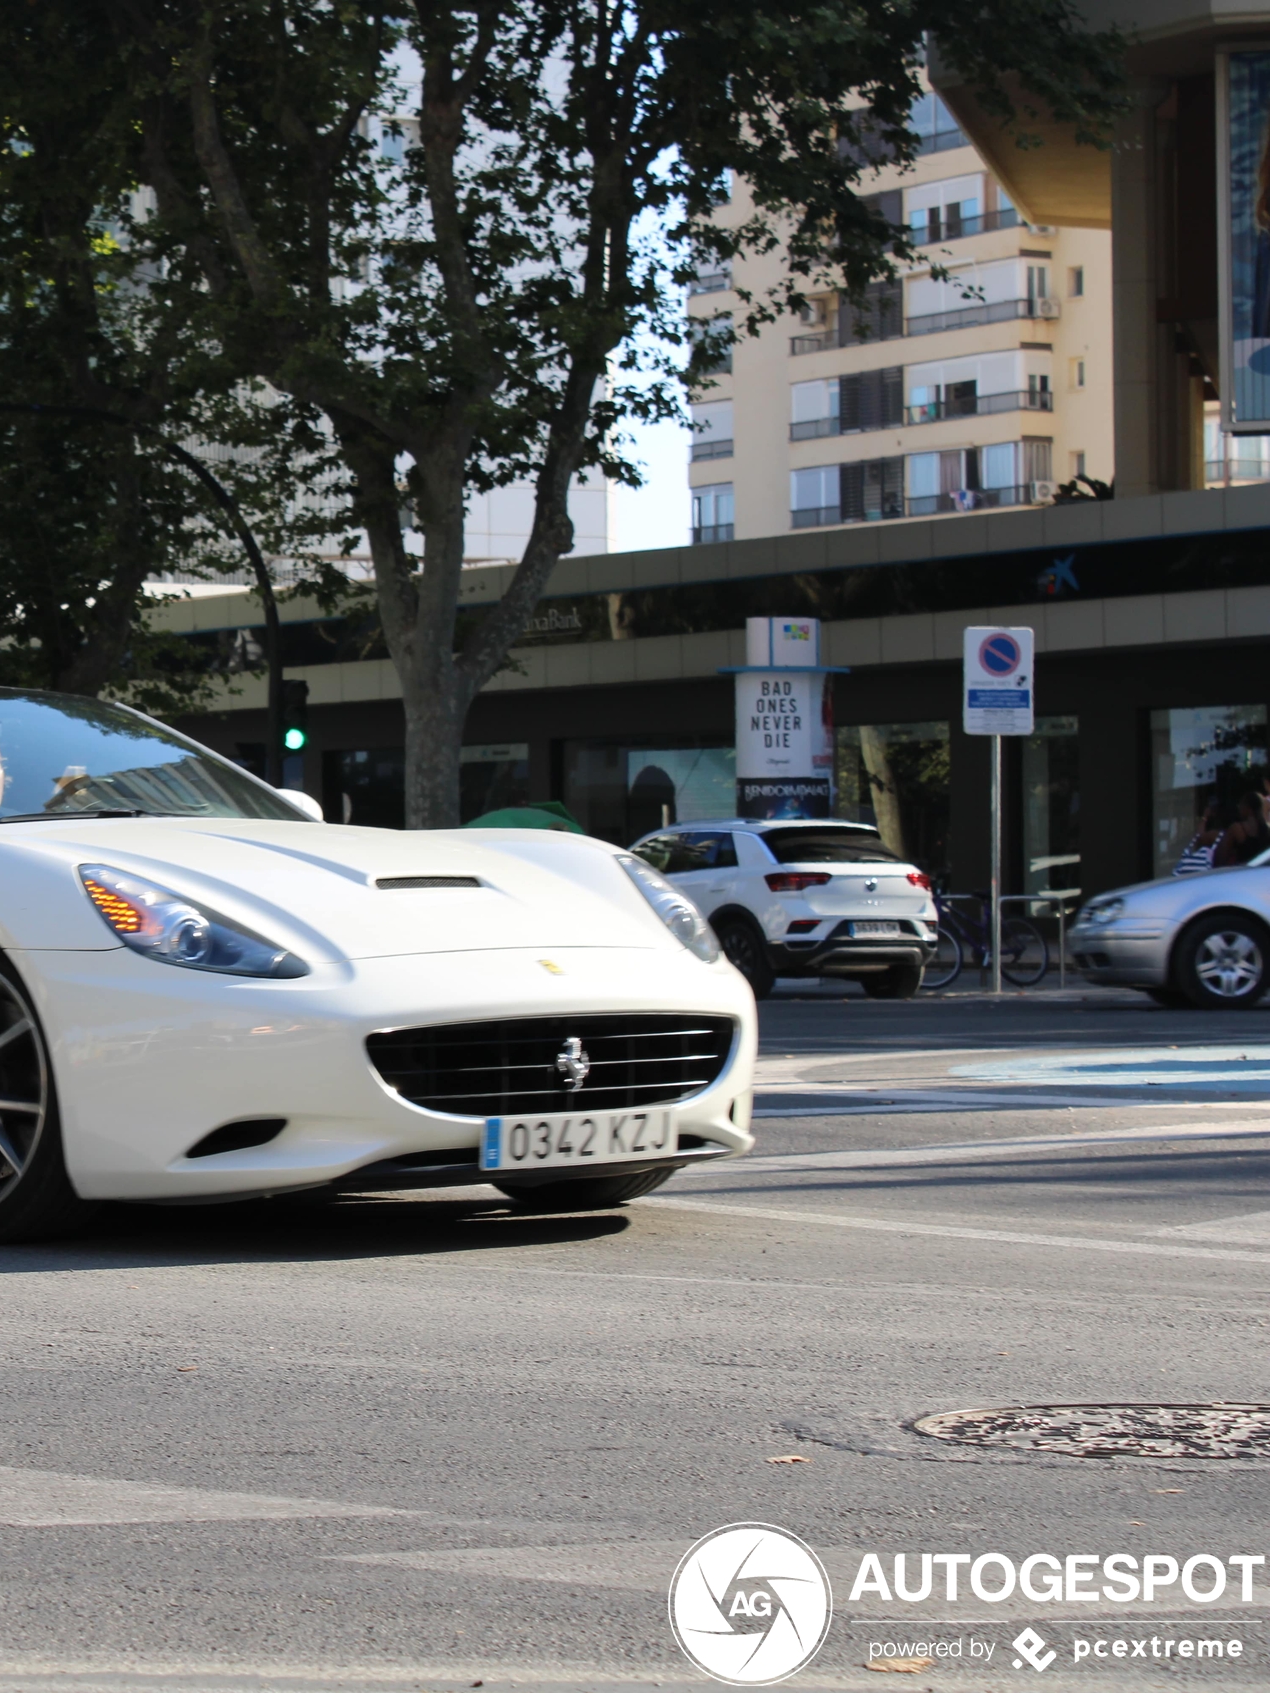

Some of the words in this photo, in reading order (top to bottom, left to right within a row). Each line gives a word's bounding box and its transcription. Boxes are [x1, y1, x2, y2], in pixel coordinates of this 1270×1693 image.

[522, 606, 582, 632] aixaBank
[761, 681, 792, 696] BAD
[756, 698, 798, 714] ONES
[751, 716, 802, 731] NEVER
[764, 733, 791, 748] DIE
[509, 1118, 598, 1162] 0342
[607, 1111, 671, 1154] KZJ
